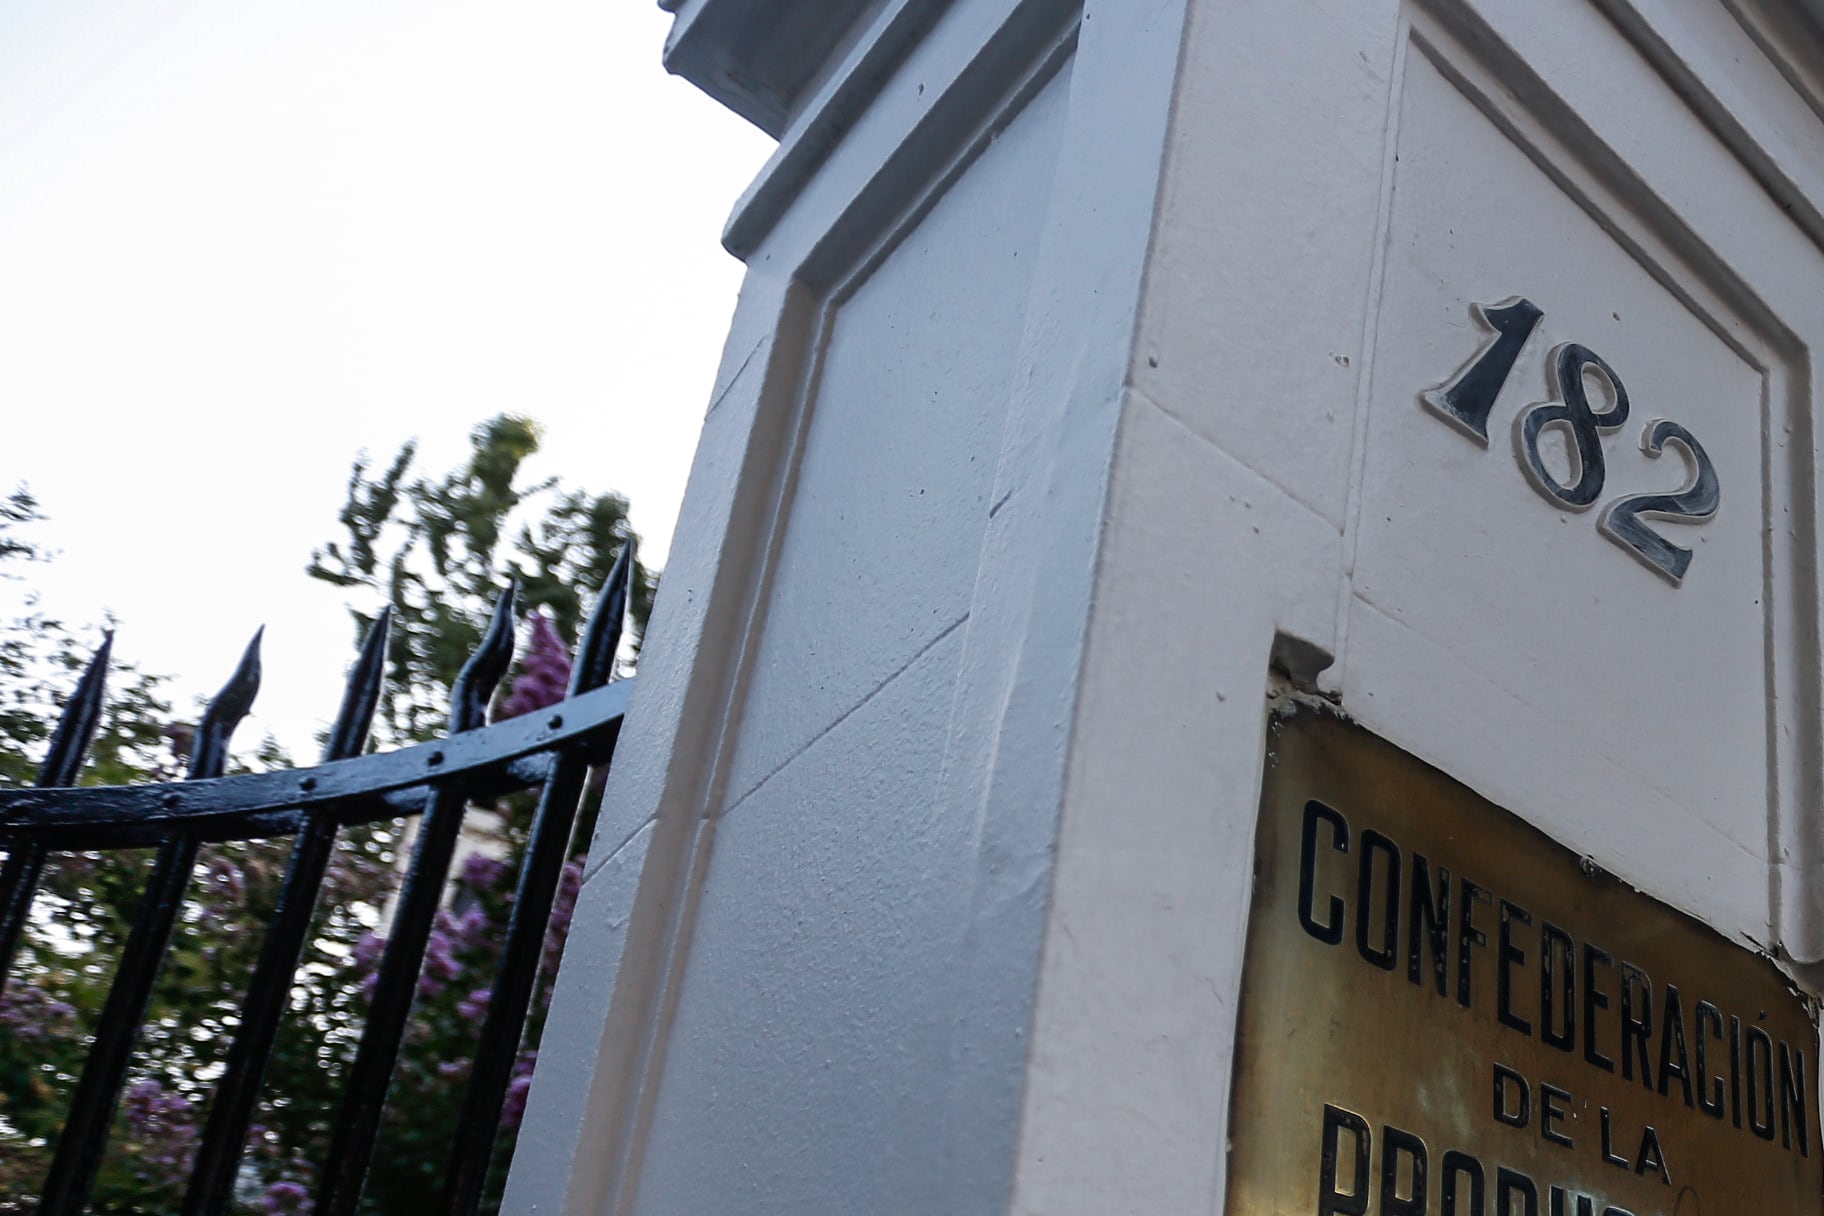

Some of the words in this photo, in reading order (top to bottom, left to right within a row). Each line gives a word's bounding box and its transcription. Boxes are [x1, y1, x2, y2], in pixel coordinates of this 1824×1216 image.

[1417, 295, 1720, 588] 182
[1299, 800, 1809, 1158] CONFEDERACIÓN
[1493, 1063, 1575, 1148] DE
[1600, 1106, 1673, 1186] LA
